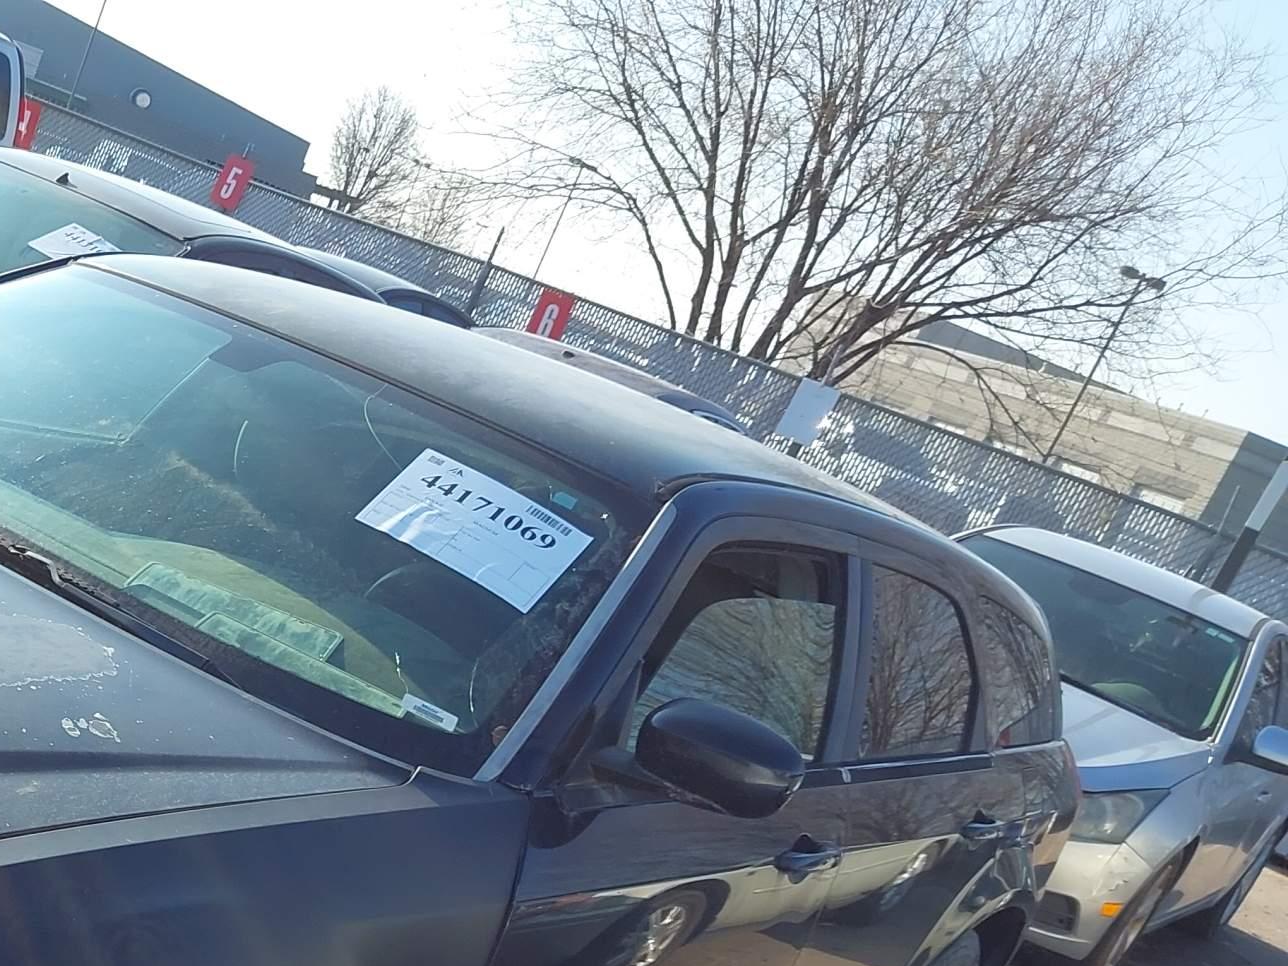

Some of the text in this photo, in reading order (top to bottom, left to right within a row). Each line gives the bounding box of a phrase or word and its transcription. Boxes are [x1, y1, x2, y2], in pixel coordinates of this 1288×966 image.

[220, 166, 243, 199] 5
[536, 303, 560, 337] 6
[420, 475, 557, 549] 44171069
